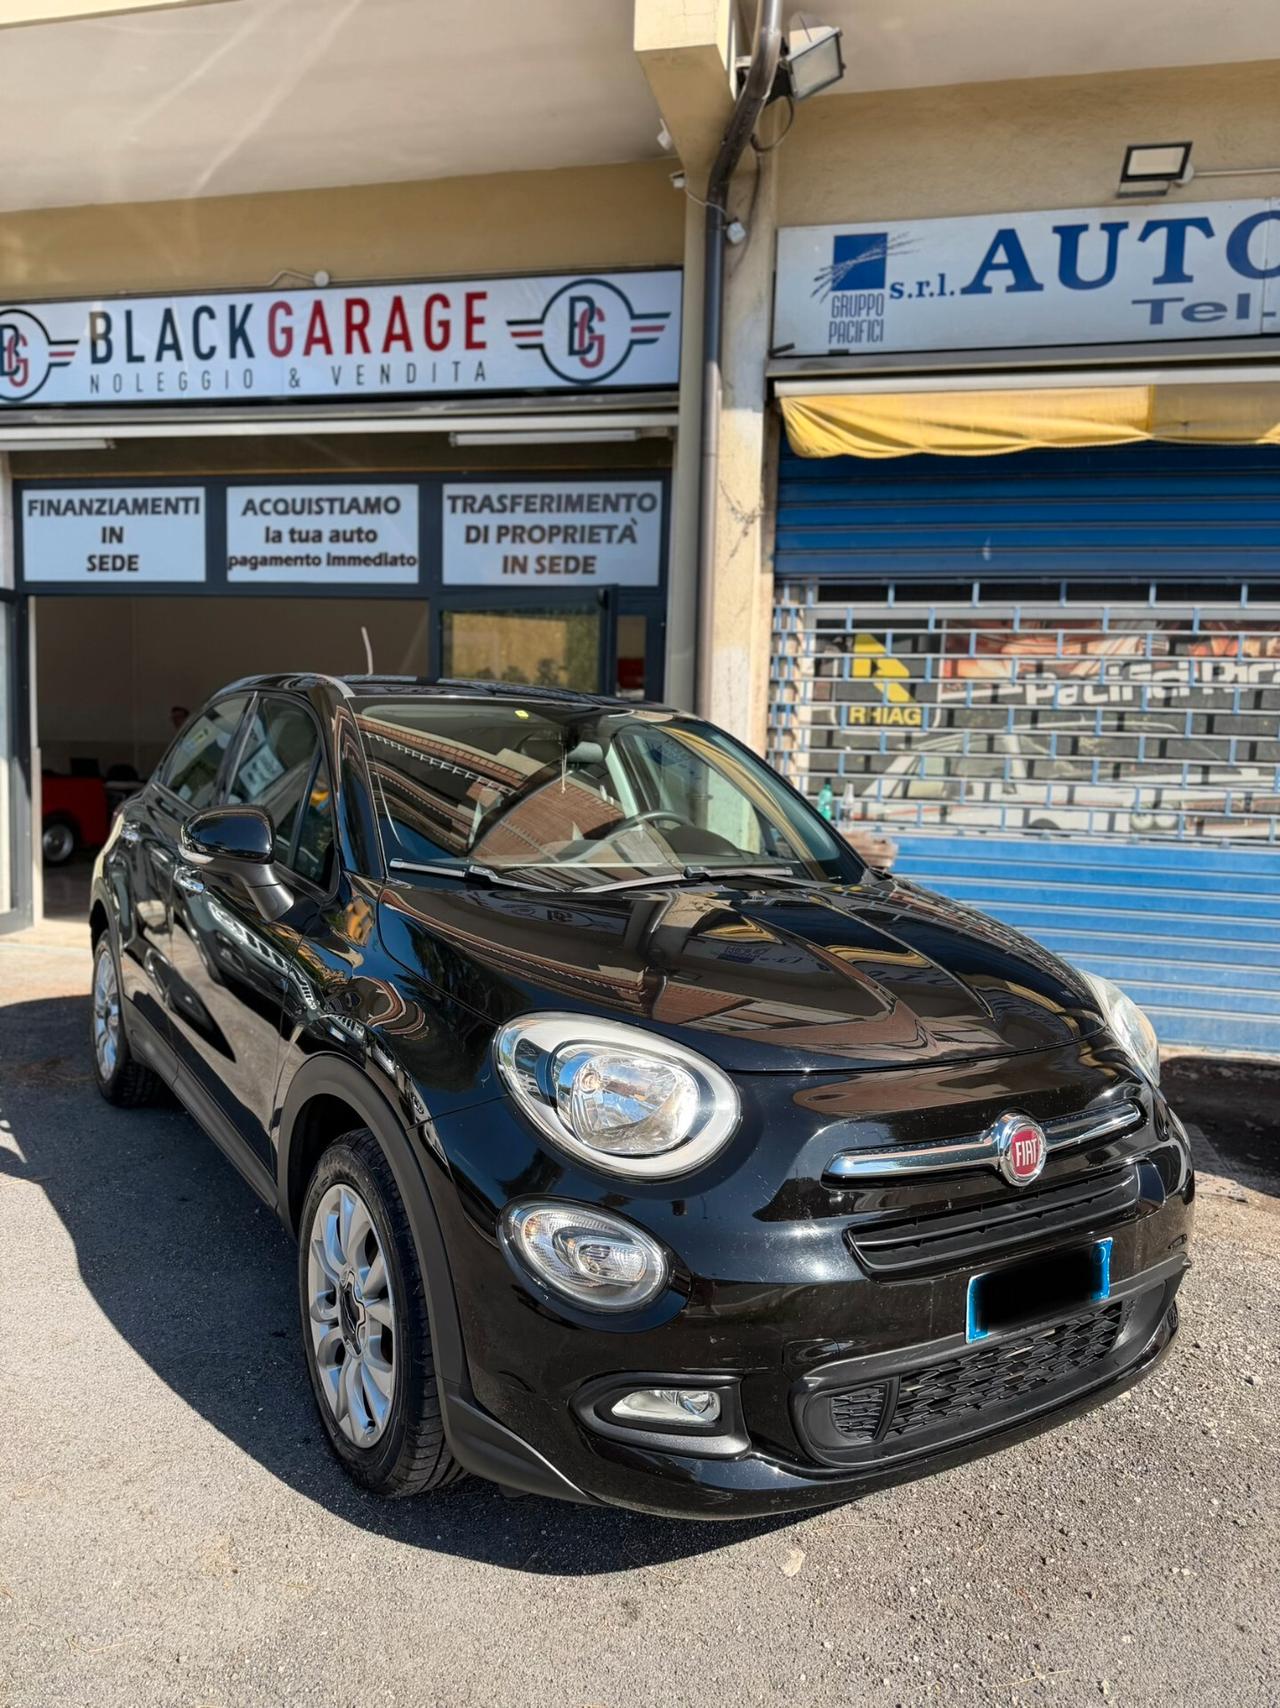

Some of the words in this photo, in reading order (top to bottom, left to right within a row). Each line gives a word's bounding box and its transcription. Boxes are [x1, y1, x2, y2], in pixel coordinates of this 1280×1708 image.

[890, 274, 955, 300] s.r.l.
[831, 293, 884, 318] GRUPPO
[828, 318, 884, 344] PACIFICI
[90, 369, 254, 394] NOLEGGIO
[289, 370, 300, 388] &
[331, 361, 486, 387] VENDITA
[28, 496, 200, 516] FINANZIAMENTI
[241, 496, 401, 516] ACQUISTIAMO
[447, 493, 657, 514] TRASFERIMENTO
[101, 527, 124, 543] IN
[264, 526, 283, 544] la
[288, 528, 323, 544] tua
[329, 528, 378, 544] auto
[465, 525, 489, 545] DI
[496, 518, 637, 544] PROPRIETÀ
[87, 555, 139, 572] SEDE
[228, 553, 322, 571] pagamento
[502, 556, 528, 574] IN
[534, 556, 596, 574] SEDE
[1015, 1138, 1037, 1167] FIAT
